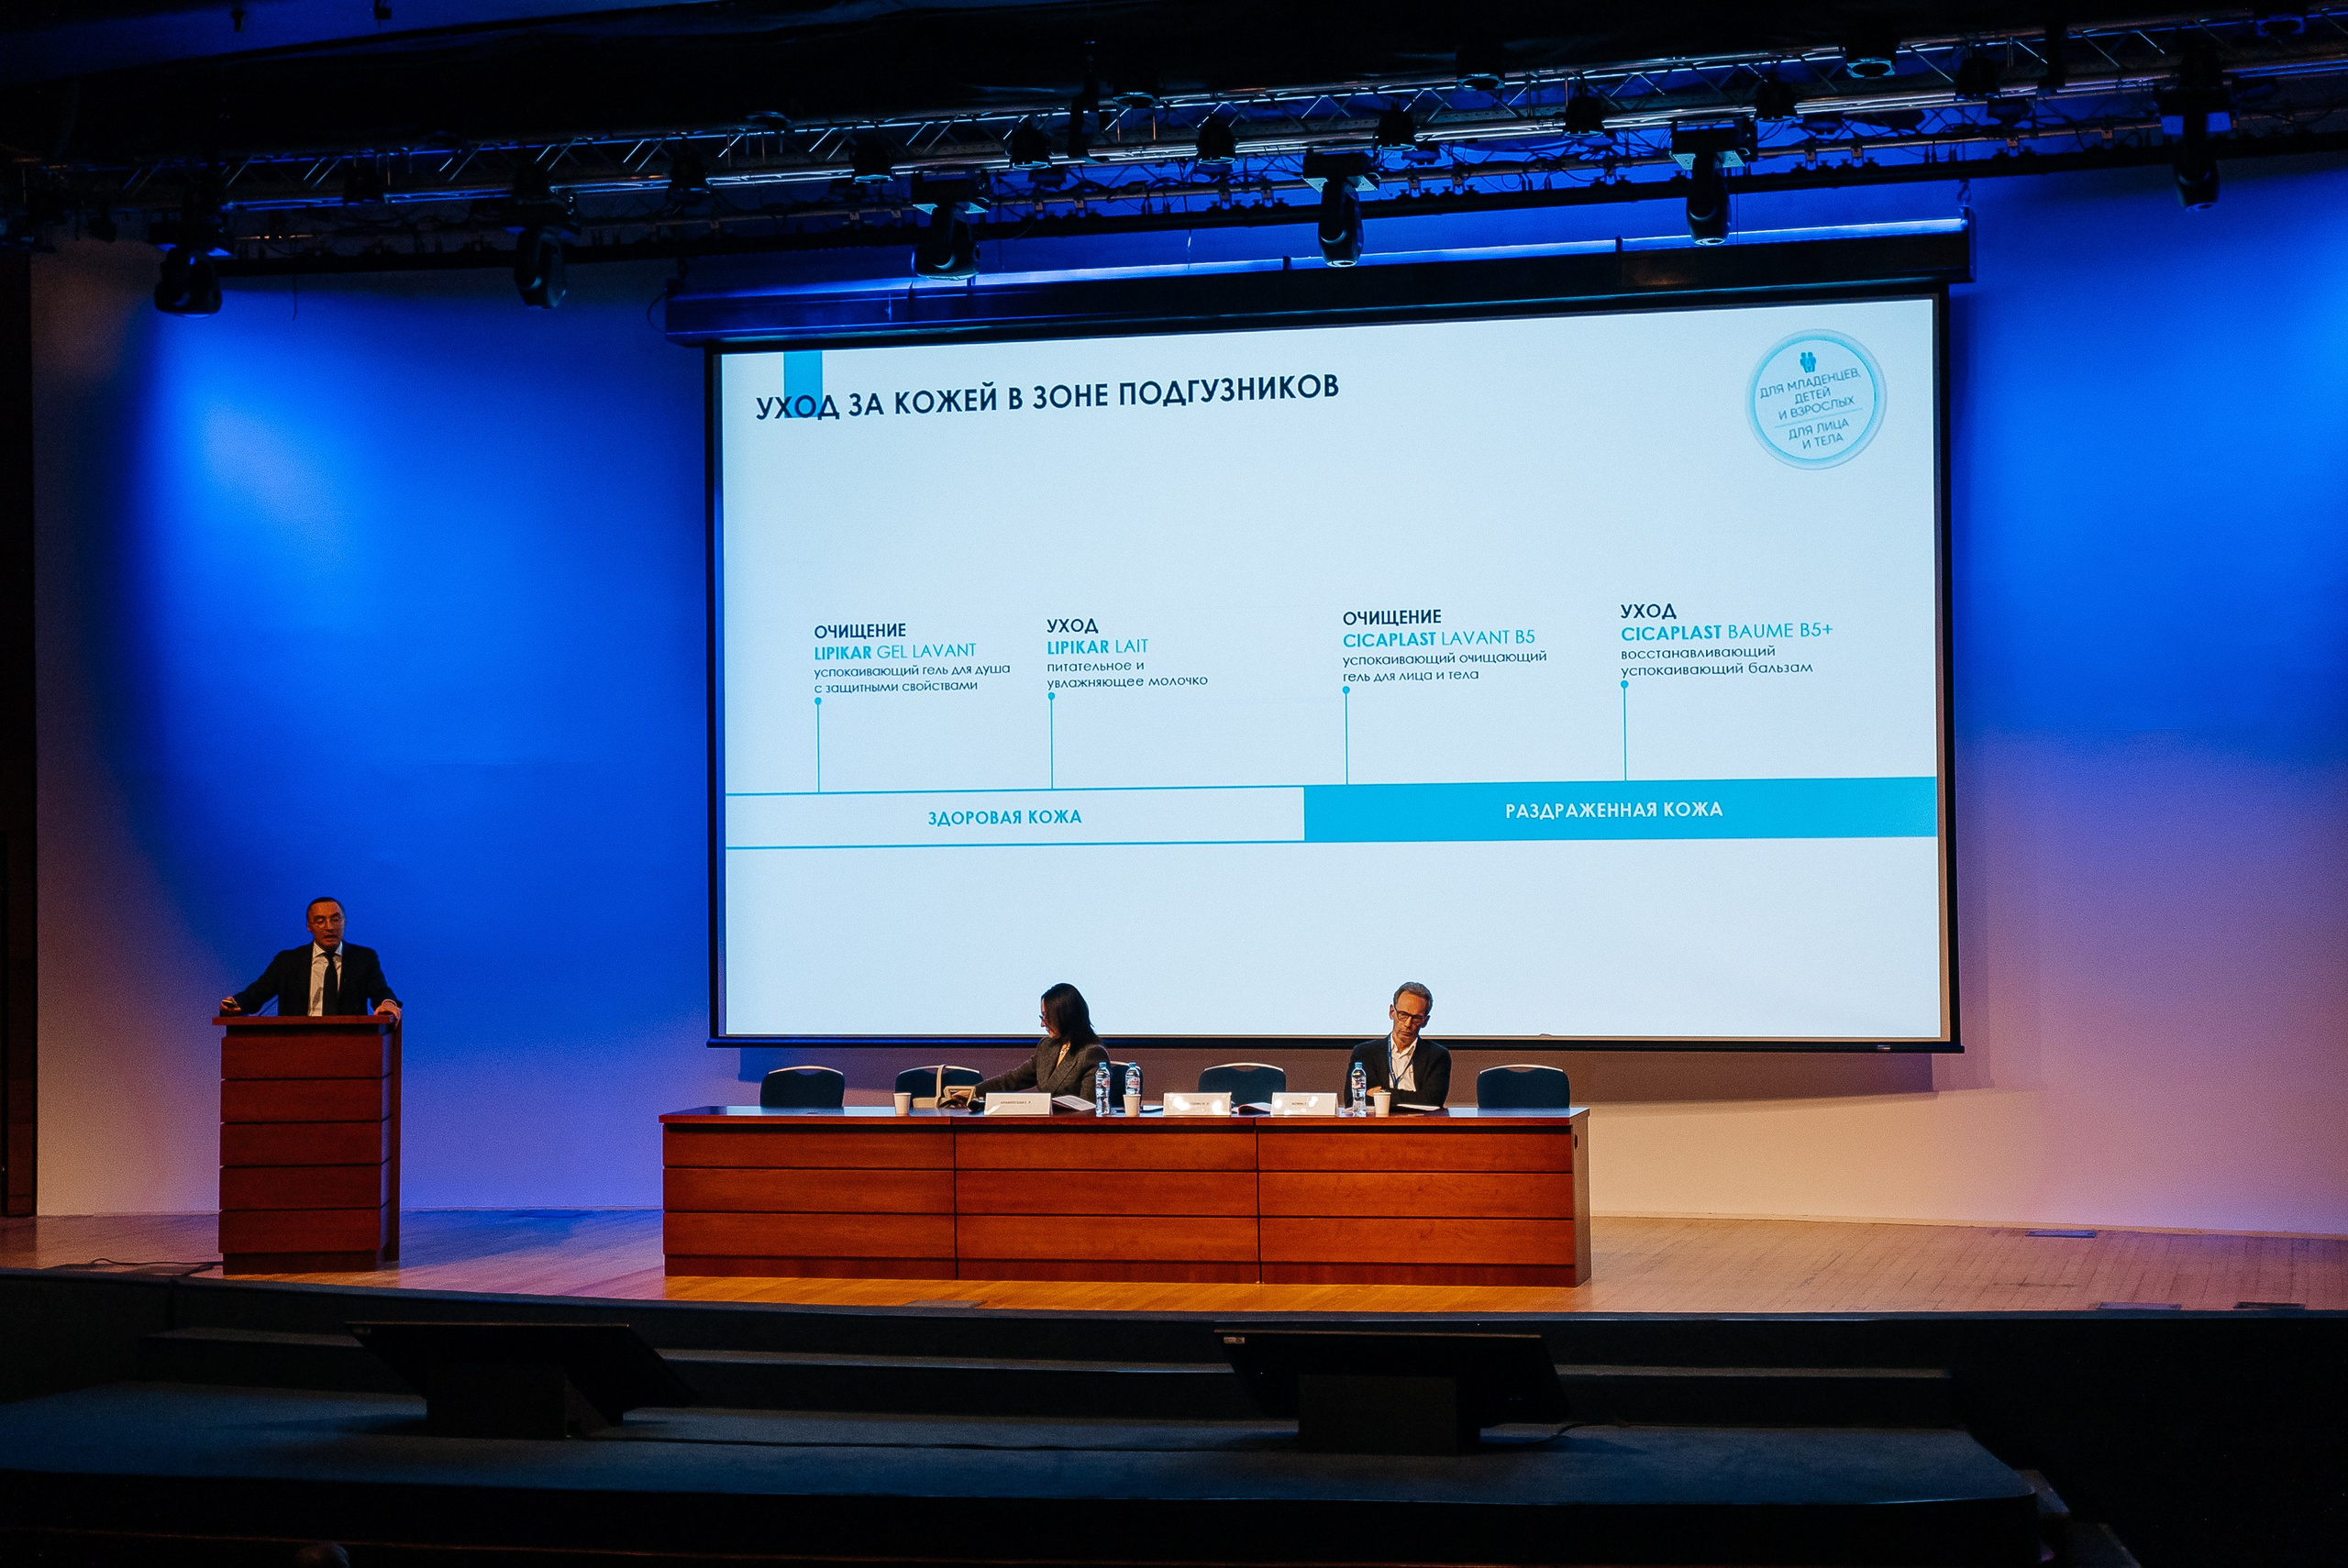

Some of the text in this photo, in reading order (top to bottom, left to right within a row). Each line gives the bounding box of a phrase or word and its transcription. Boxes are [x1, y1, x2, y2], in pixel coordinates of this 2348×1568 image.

[757, 374, 1338, 420] УХОД ЗА КОЖЕЙ В ЗОНЕ ПОДГУЗНИКОВ
[1760, 384, 1784, 398] ДЛЯ
[1795, 386, 1831, 404] ДЕТЕЙ
[1778, 396, 1855, 420] И ВЗРОСЛЫХ
[1789, 419, 1849, 441] ДЛЯ ЛИЦА
[1802, 433, 1844, 448] И ТЕЛА
[1344, 610, 1441, 626] ОЧИЩЕНИЕ
[1621, 603, 1677, 620] УХОД
[814, 624, 905, 639] ОЧИЩЕНИЕ
[1047, 618, 1098, 634] УХОД
[1622, 623, 1833, 641] CICAPLAST BAUME B5+
[1344, 630, 1534, 647] CICAPLAST LAVANT B5
[815, 643, 975, 660] LIPIKAR GEL LAVANT
[1047, 639, 1147, 655] LIPIKAR LAIT
[1622, 646, 1775, 660] восстанавливающий
[1047, 662, 1131, 671] питательное
[1343, 650, 1546, 668] успокаивающий очищающий
[814, 665, 1010, 679] успокаивающий гель для душа
[1344, 673, 1370, 682] гель
[1374, 673, 1395, 682] для
[1400, 672, 1432, 680] лица
[1449, 671, 1479, 679] тела
[1622, 662, 1812, 679] успокаивающий бальзам
[826, 684, 898, 693] защитными
[903, 680, 977, 691] свойствами
[1047, 677, 1208, 690] увлажняющее молочко
[928, 810, 1081, 827] ЗДОРОВАЯ КОЖА
[1506, 801, 1722, 820] РАЗДРАЖЕННАЯ КОЖА
